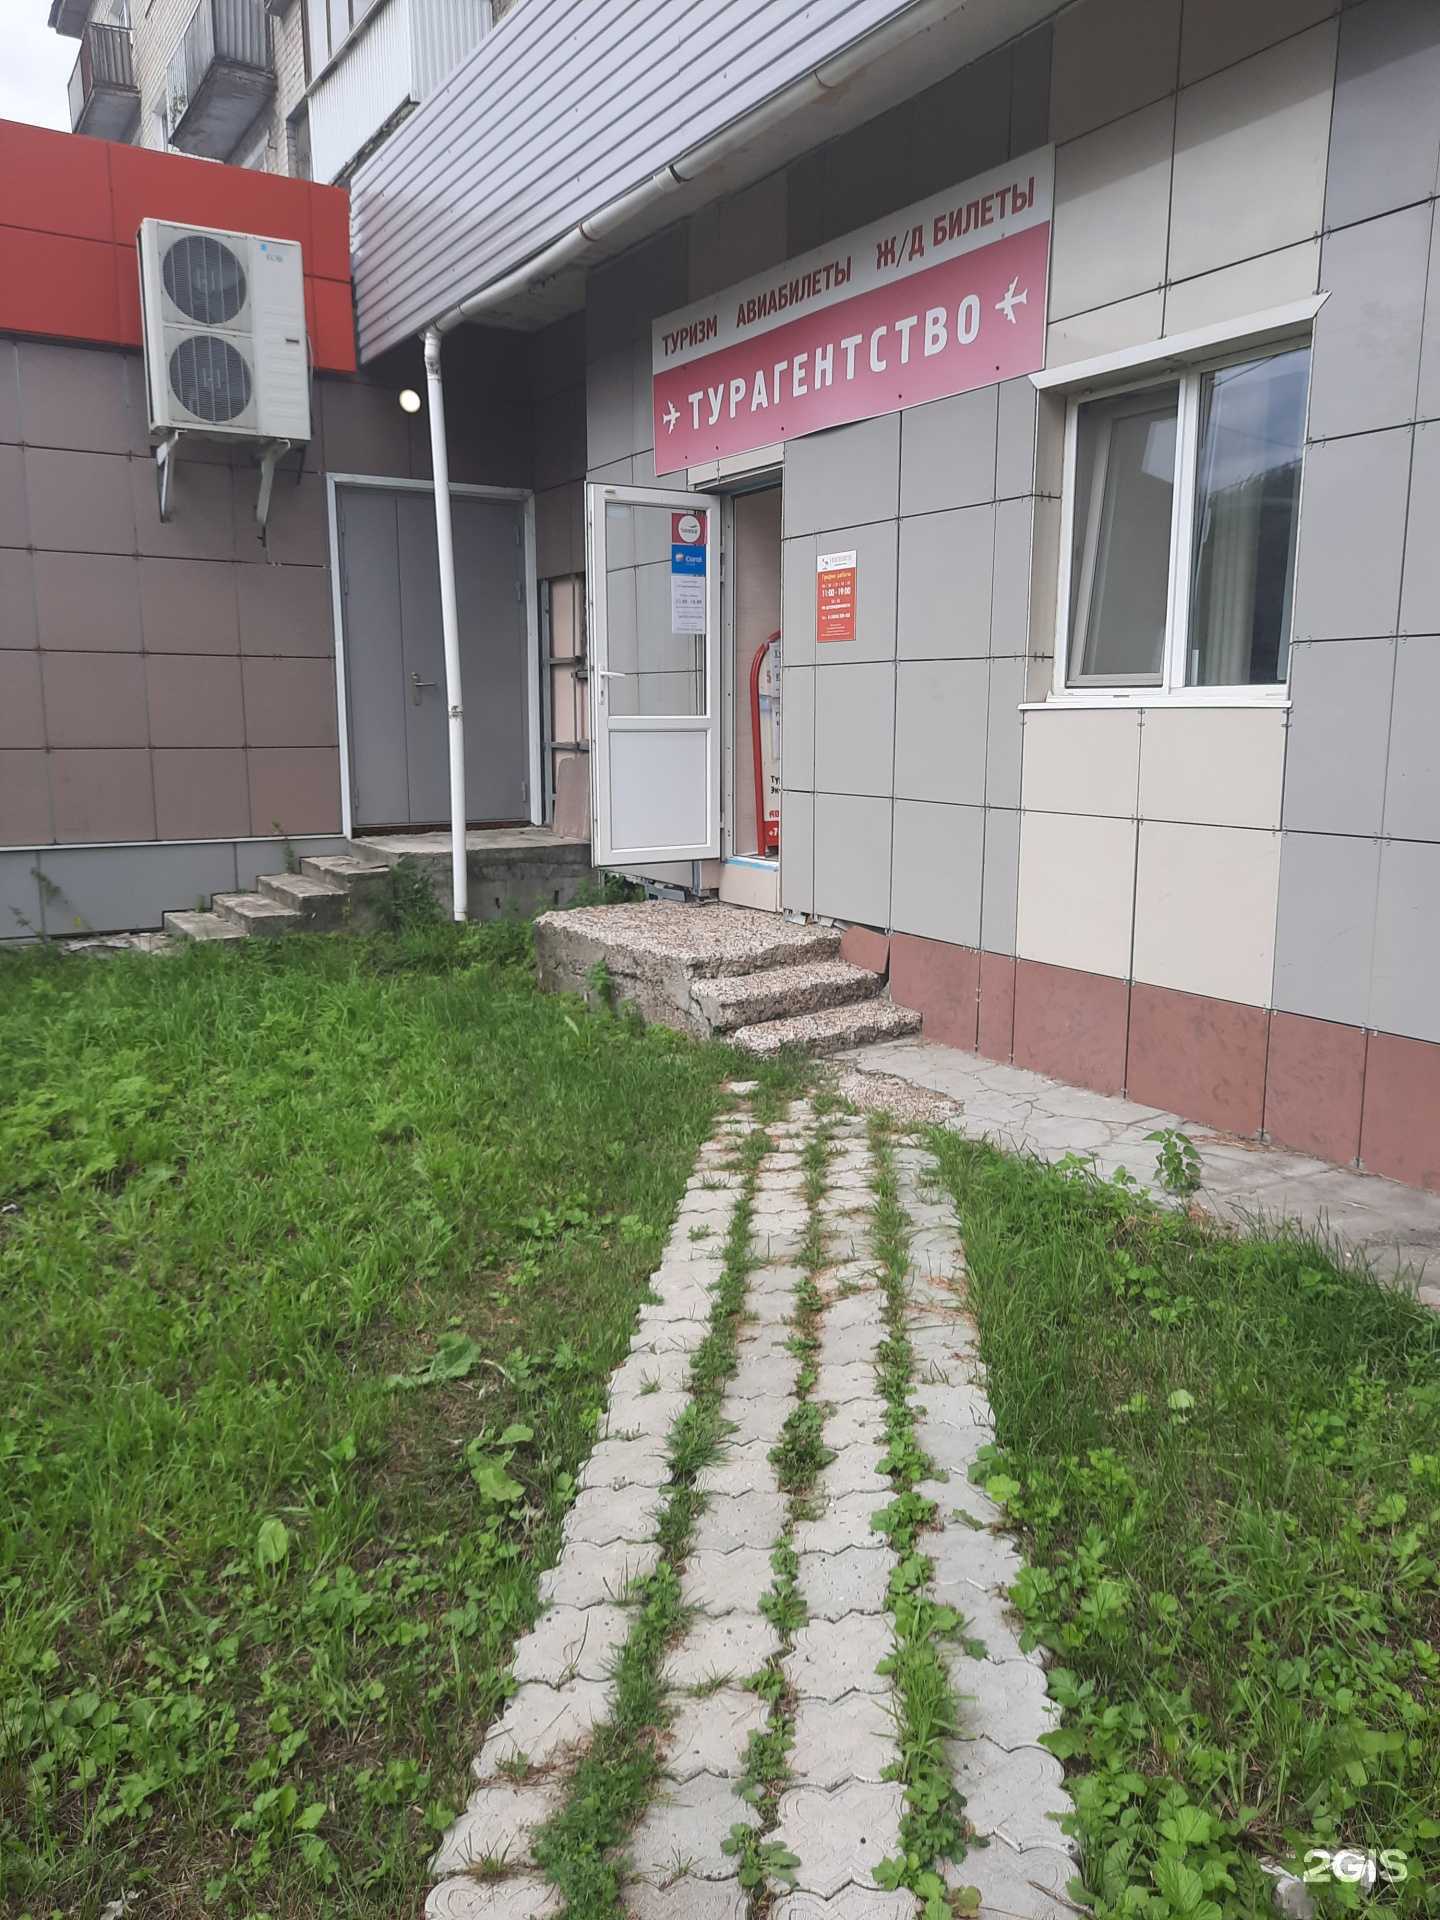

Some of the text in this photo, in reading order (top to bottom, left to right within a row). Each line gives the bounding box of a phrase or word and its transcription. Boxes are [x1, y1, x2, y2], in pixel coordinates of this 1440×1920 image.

[662, 176, 1035, 356] ТУРИЗМ АВИАБИЛЕТЫ Ж/Д БИЛЕТЫ
[688, 293, 981, 430] ТУРАГЕНТСТВО
